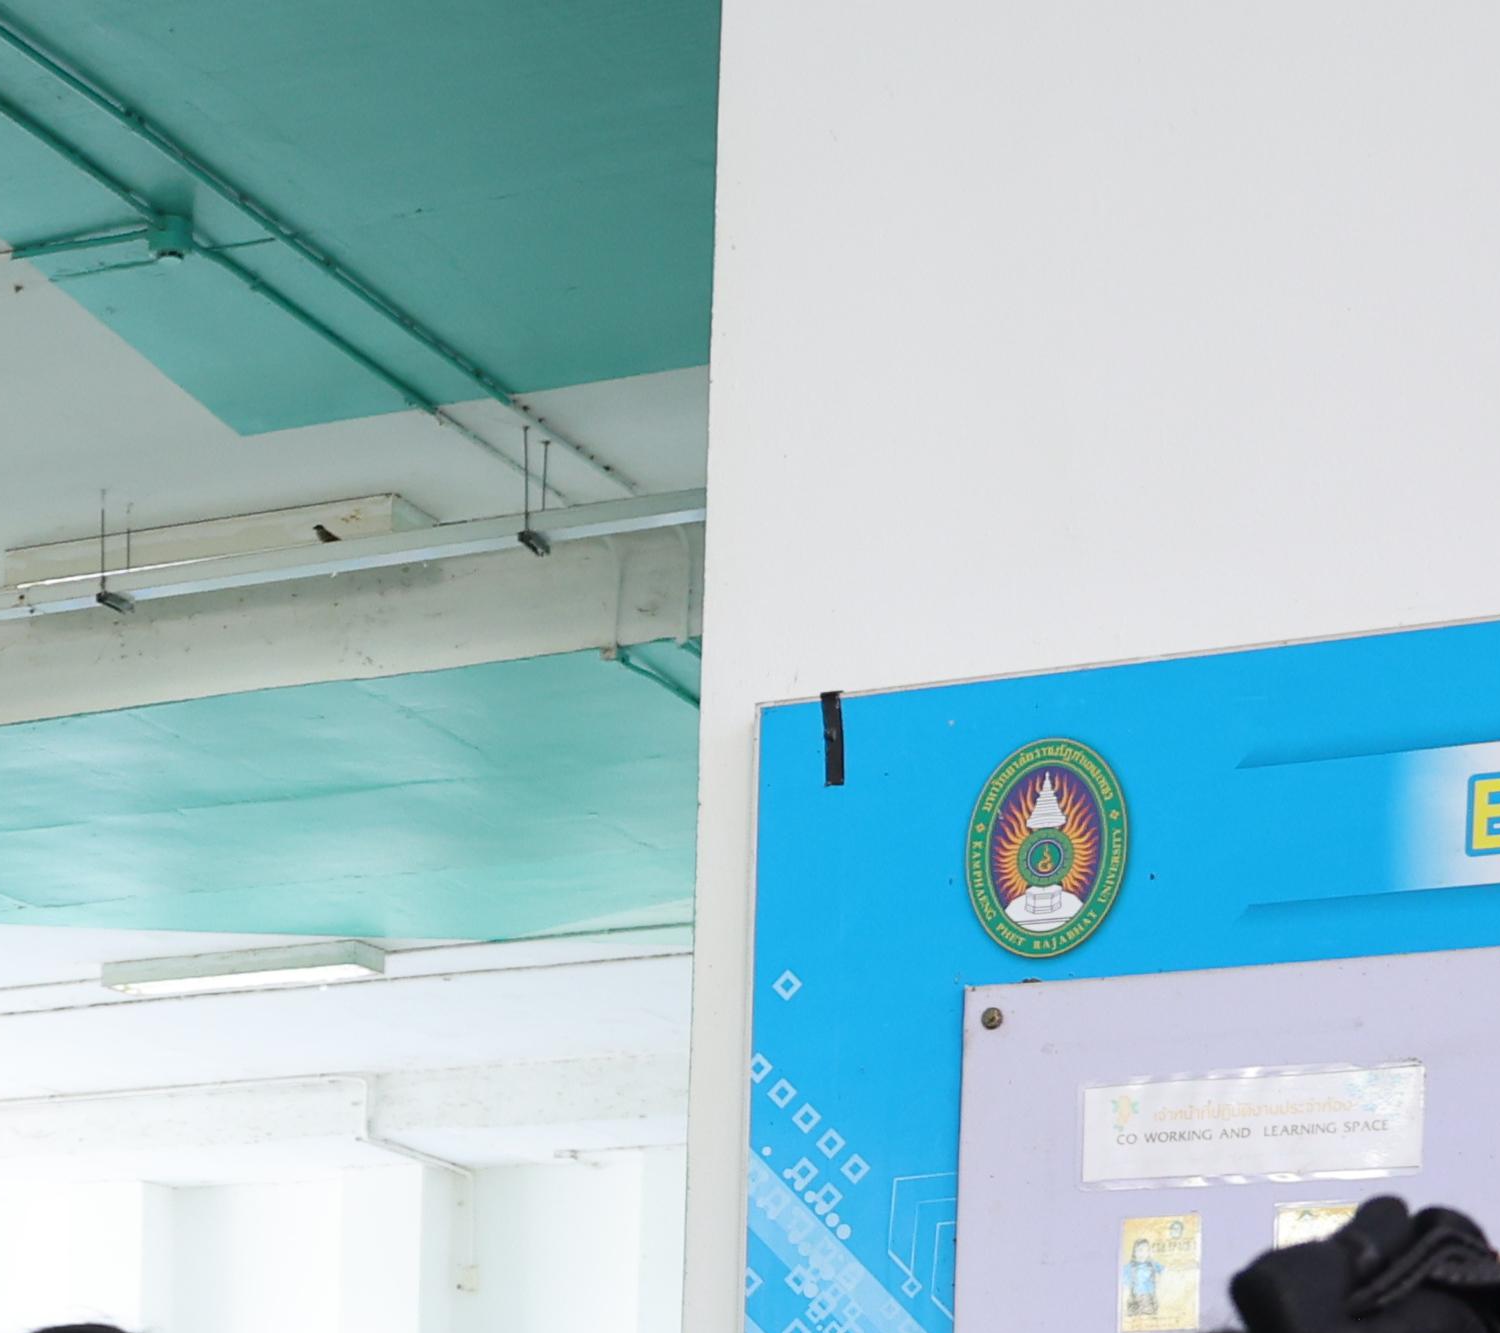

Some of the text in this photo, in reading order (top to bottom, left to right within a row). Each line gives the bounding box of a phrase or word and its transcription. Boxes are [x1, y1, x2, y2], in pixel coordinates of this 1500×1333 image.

[1116, 1119, 1389, 1146] CO WORKING AND LEARNING SPACE
